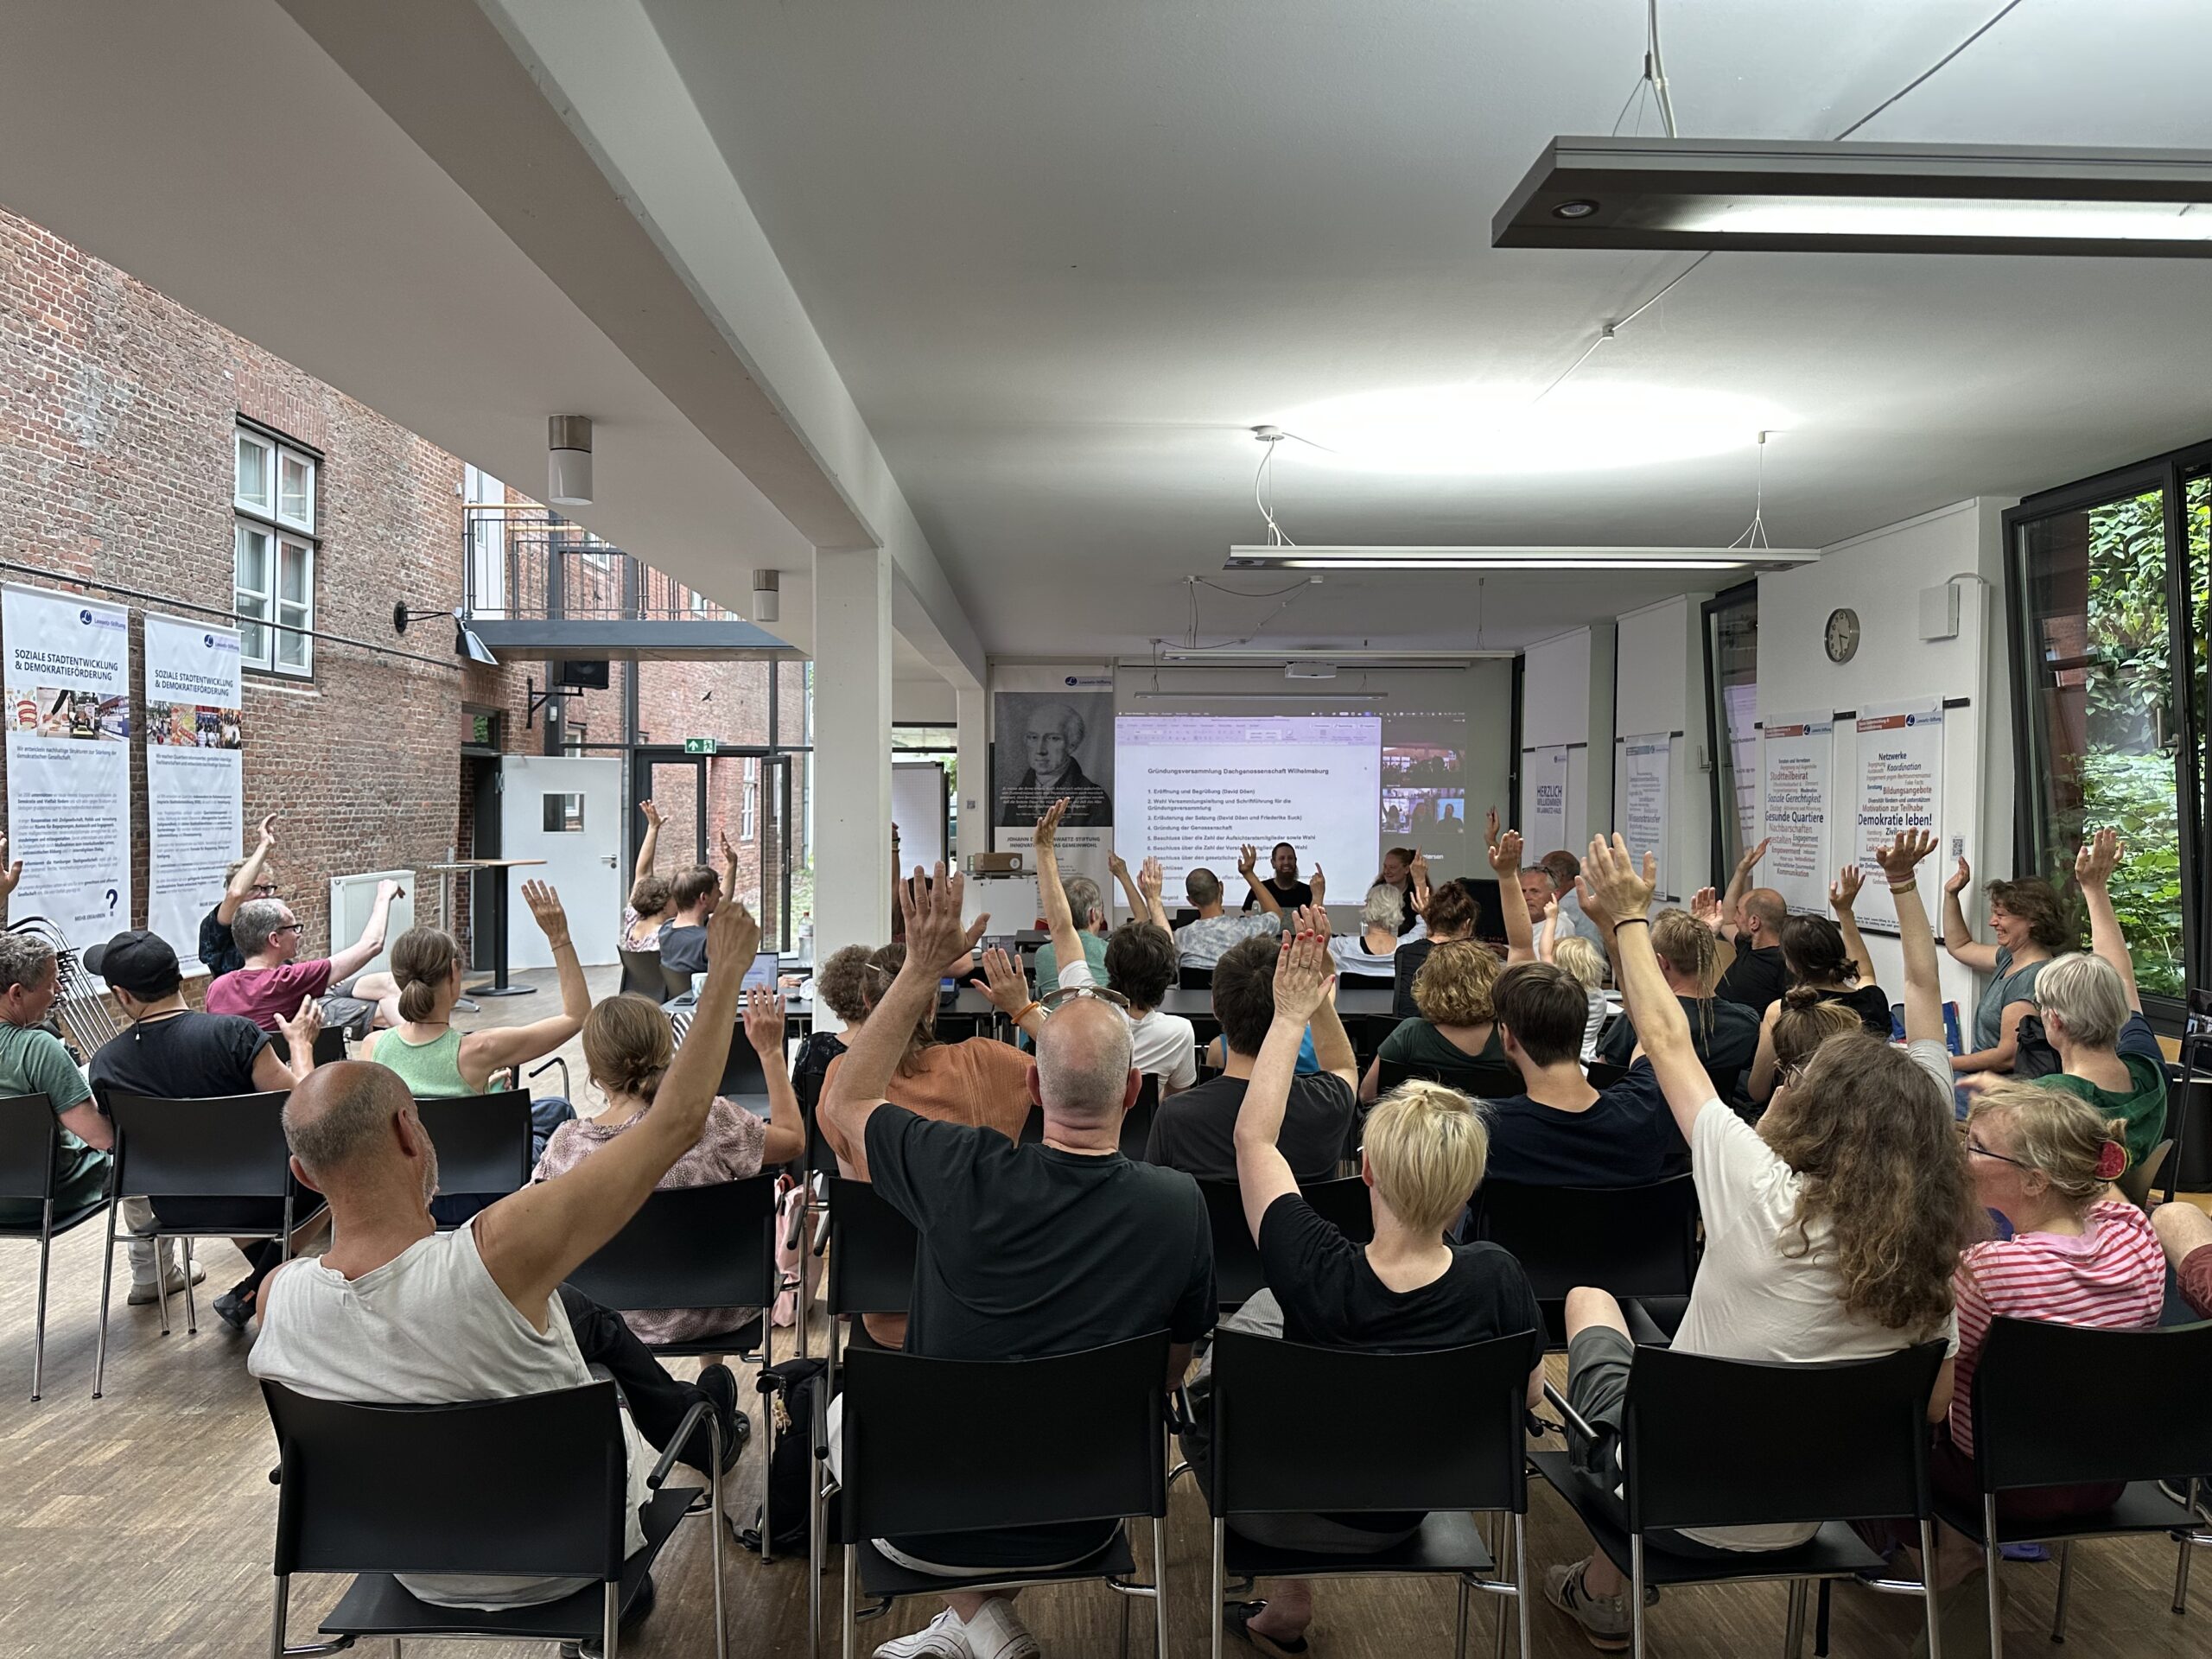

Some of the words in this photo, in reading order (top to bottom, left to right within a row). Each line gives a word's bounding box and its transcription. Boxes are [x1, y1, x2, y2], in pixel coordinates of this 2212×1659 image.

[15, 649, 46, 662] SOZIALE
[48, 653, 118, 671] STADTENTWICKLUNG
[15, 660, 22, 671] &
[24, 661, 112, 681] DEMOKRATIEFÖRDERUNG
[156, 669, 178, 681] SOZIALE
[180, 672, 233, 689] STADTENTWICKLUNG
[156, 680, 161, 689] &
[162, 680, 229, 696] DEMOKRATIEFÖRDERUNG
[1878, 751, 1907, 760] Netzwerke
[1886, 762, 1922, 772] Koordination
[1770, 771, 1808, 780] Stadtteilbeirat
[1537, 785, 1562, 798] HERZLICH
[1883, 785, 1932, 796] Bildungsangebote
[1767, 793, 1784, 803] Soziale
[1785, 793, 1821, 805] Gerechtigkeit
[1862, 804, 1889, 812] Motivation
[1900, 804, 1923, 812] Teilhabe
[1765, 810, 1790, 822] Gesunde
[1792, 811, 1824, 823] Quartiere
[1858, 813, 1904, 825] Demokratie
[1905, 813, 1932, 825] leben!
[1769, 823, 1813, 834] Nachbarschaften
[1793, 834, 1819, 843] Engagement
[1777, 868, 1809, 877] Kommunikation
